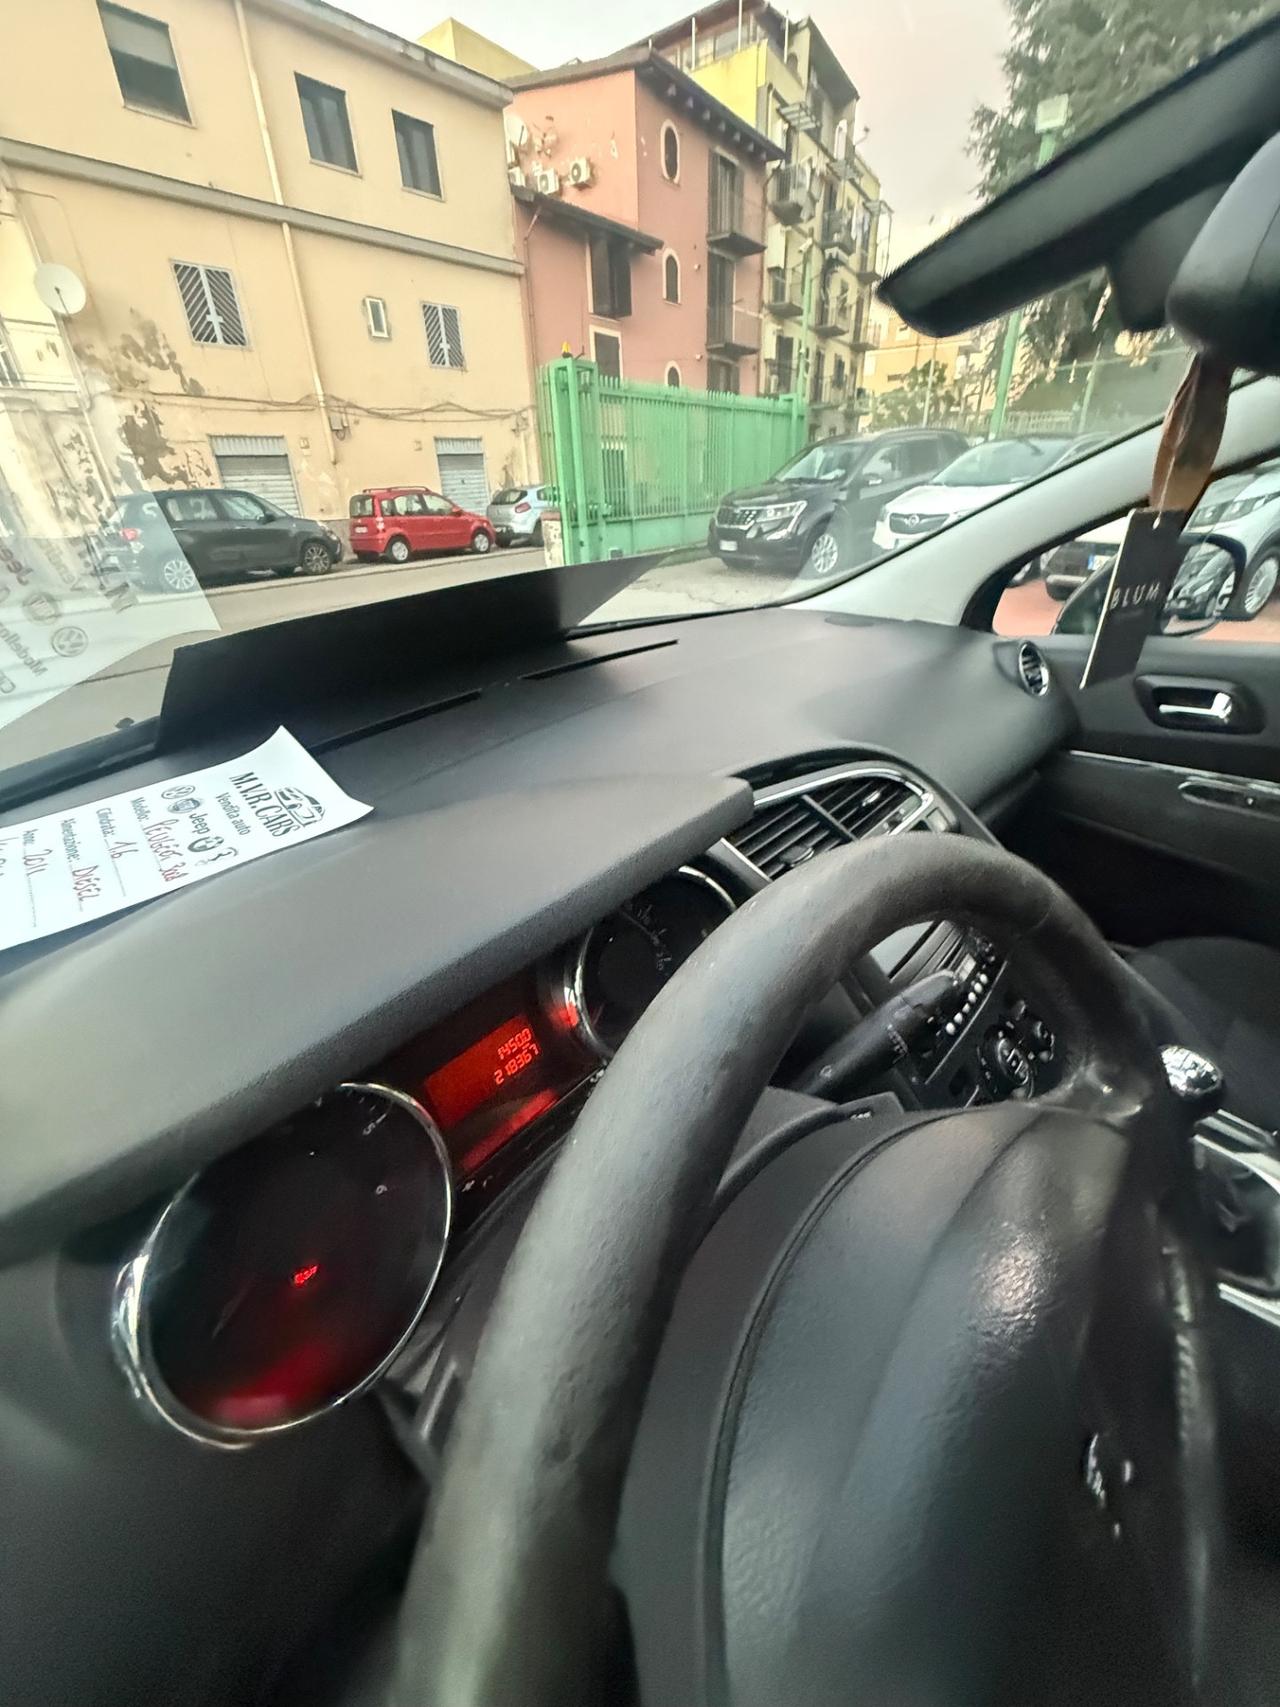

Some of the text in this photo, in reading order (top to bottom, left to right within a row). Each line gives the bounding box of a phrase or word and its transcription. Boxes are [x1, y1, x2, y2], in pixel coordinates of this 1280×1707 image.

[1110, 582, 1160, 610] BLUM
[189, 813, 211, 834] Jeep
[215, 792, 251, 836] Vendita auto
